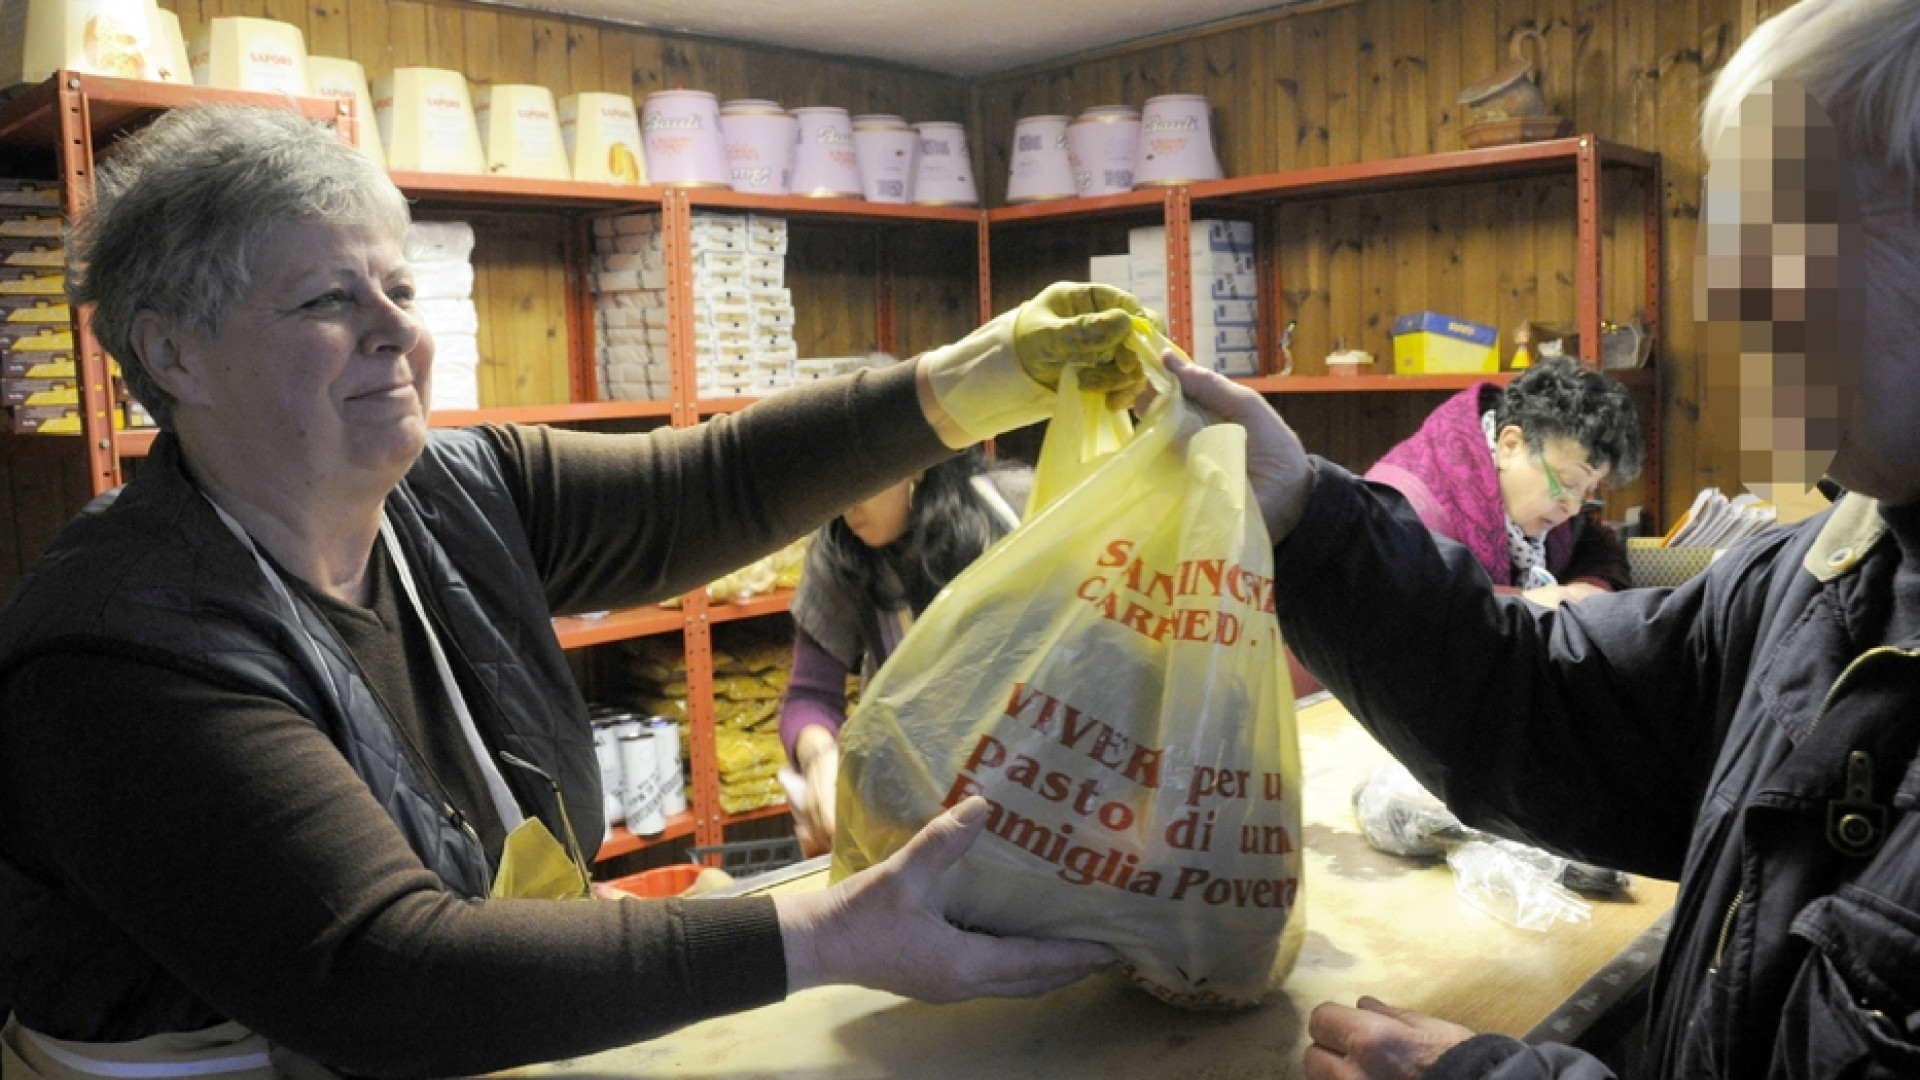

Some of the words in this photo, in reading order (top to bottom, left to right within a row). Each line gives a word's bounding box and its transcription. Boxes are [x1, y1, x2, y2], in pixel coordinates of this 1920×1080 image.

[249, 52, 293, 66] SAPORI
[964, 733, 1135, 832] pasto
[1164, 810, 1216, 852] di
[1185, 765, 1251, 807] per
[941, 772, 1162, 897] Famiglia
